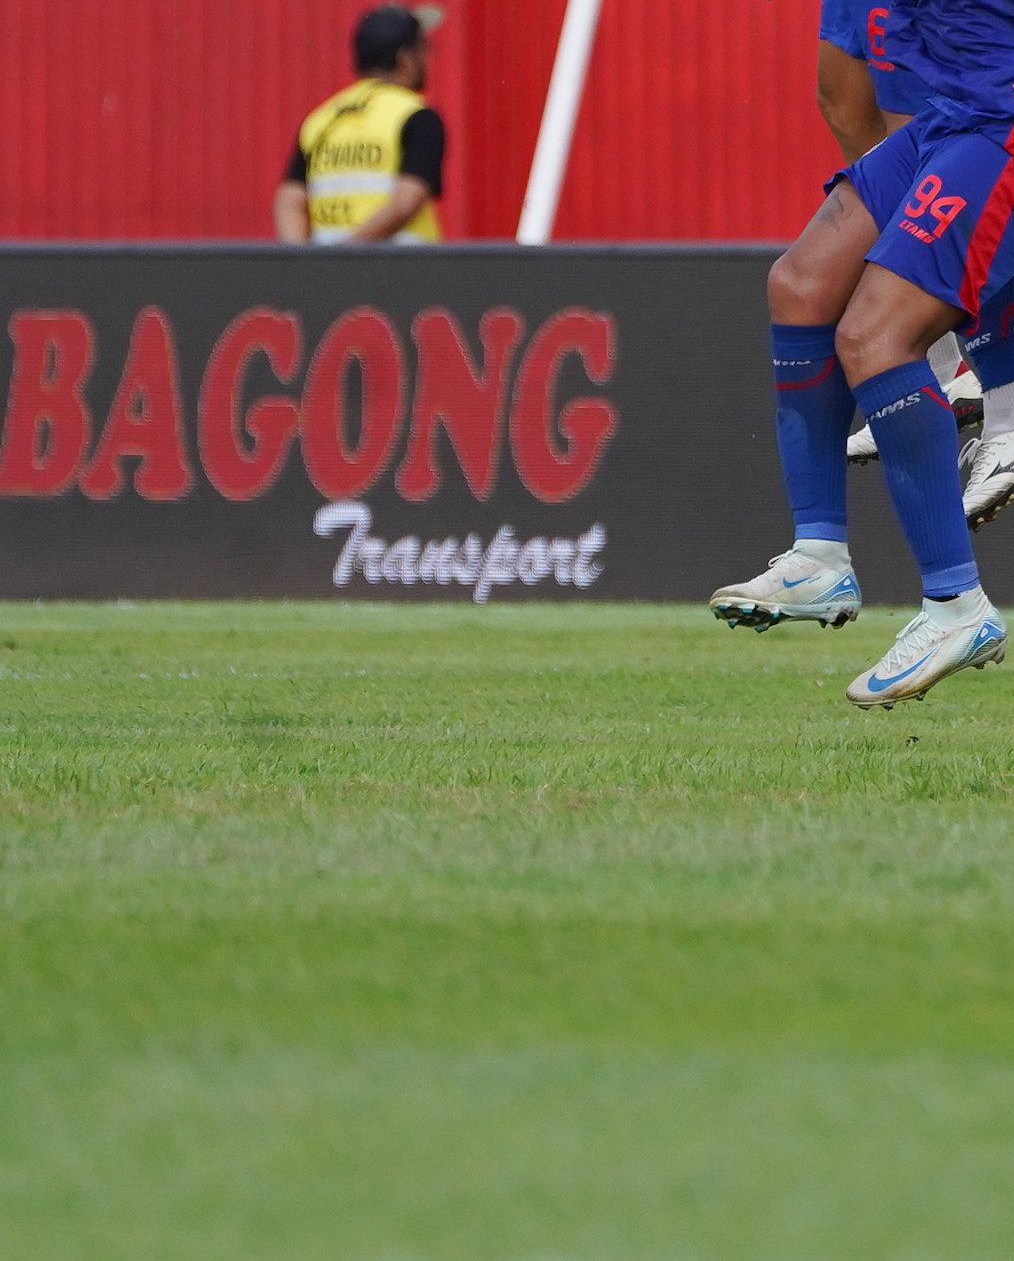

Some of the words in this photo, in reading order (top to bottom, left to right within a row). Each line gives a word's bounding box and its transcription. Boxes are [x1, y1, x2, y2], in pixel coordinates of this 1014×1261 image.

[904, 174, 968, 238] 94
[0, 304, 620, 503] BAGONG
[313, 499, 608, 604] Transport
